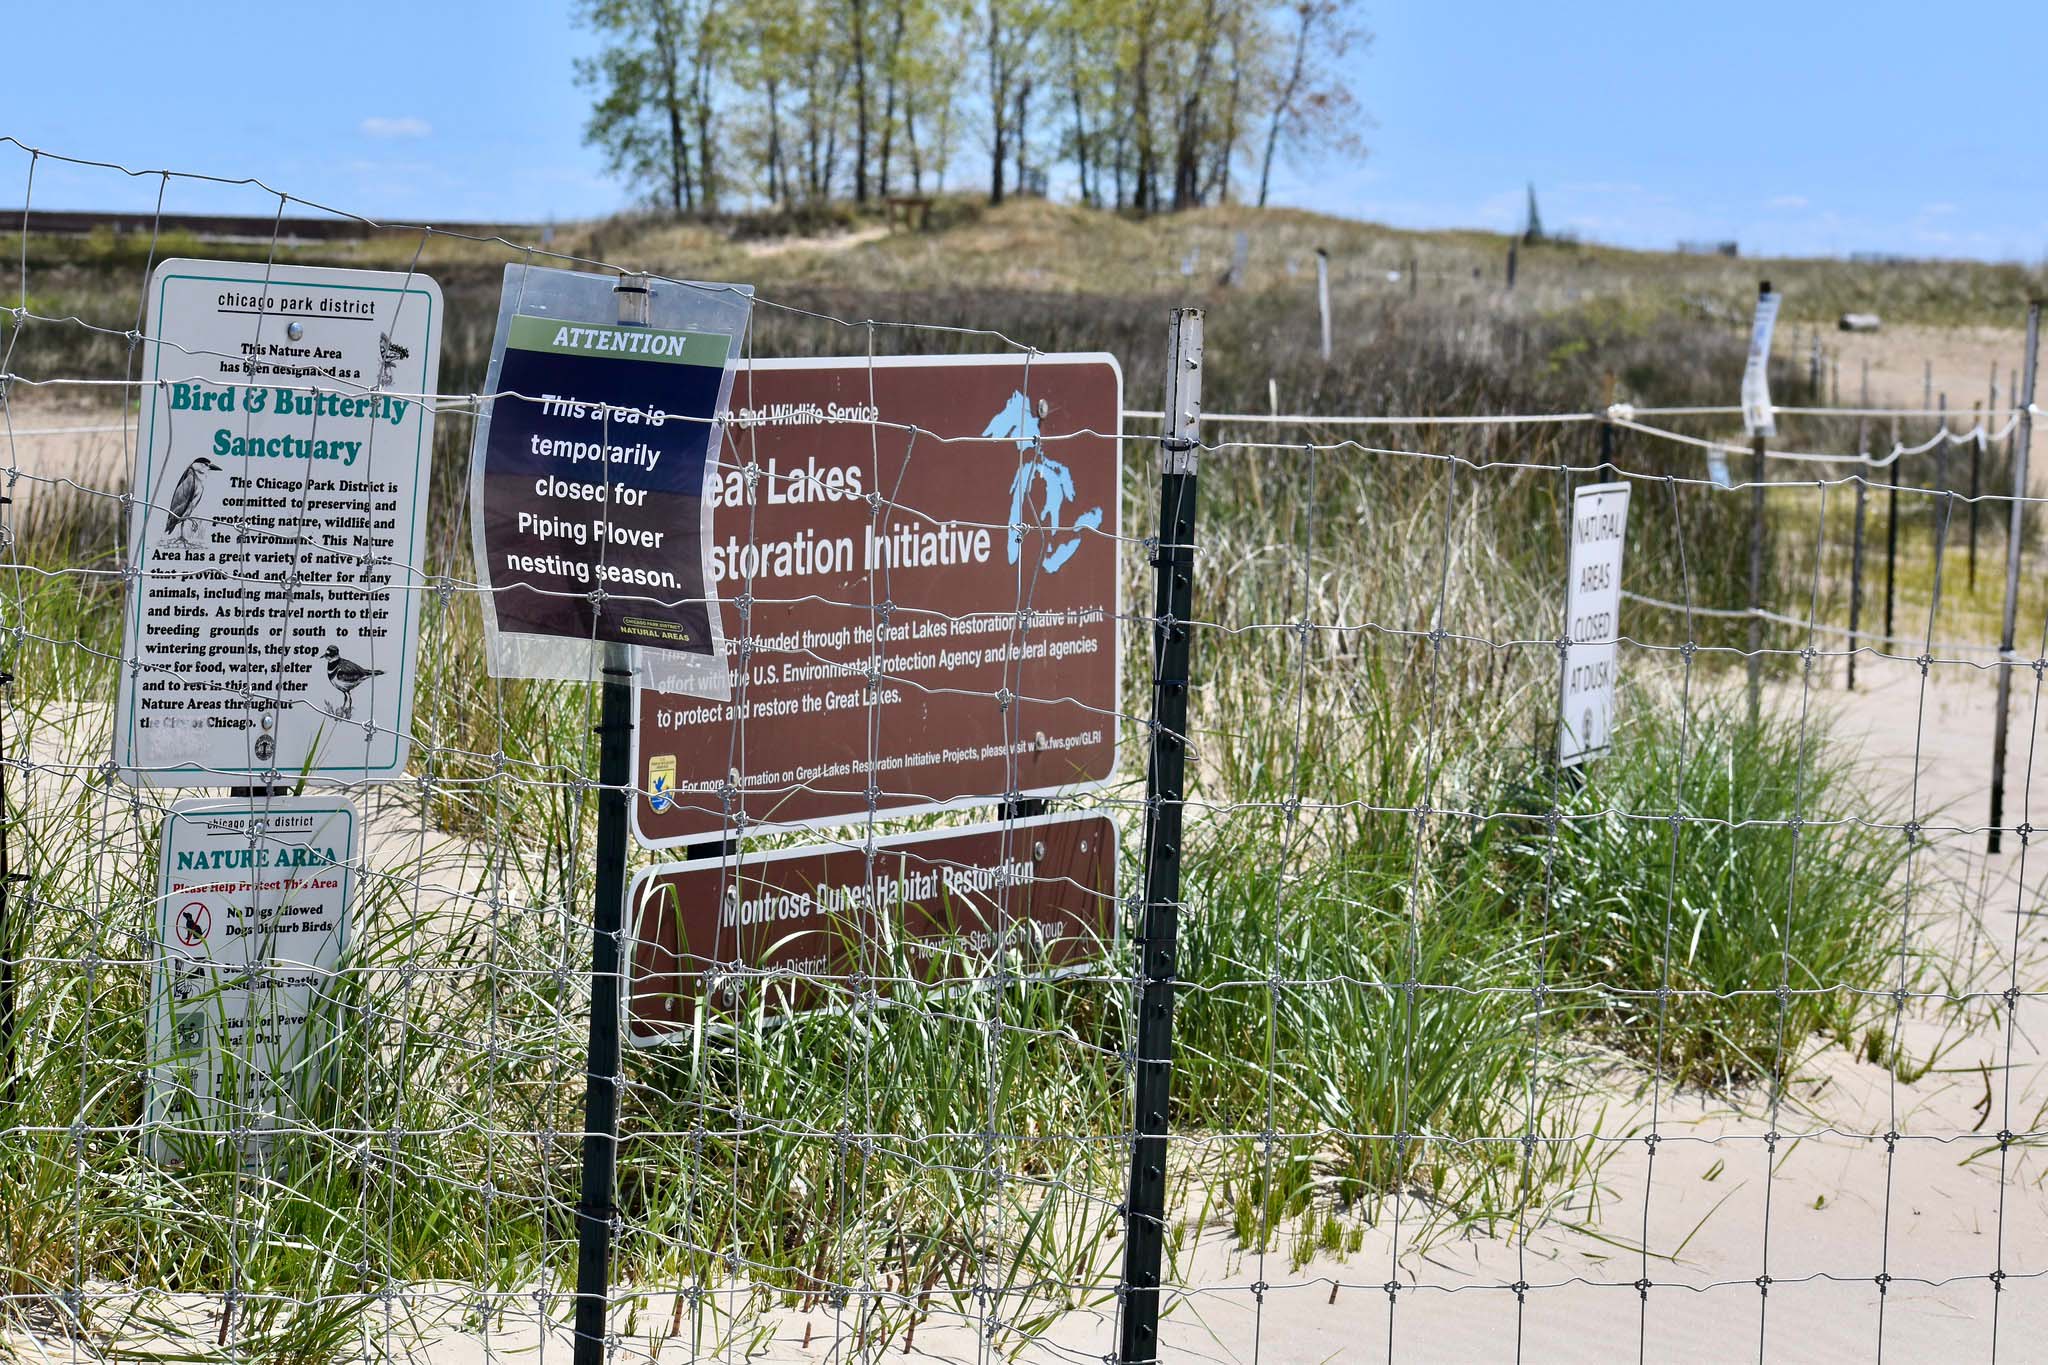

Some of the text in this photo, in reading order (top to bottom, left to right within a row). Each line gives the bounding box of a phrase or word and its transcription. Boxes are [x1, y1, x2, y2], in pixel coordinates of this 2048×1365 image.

[218, 292, 375, 315] chicago park district
[241, 343, 342, 359] This Nature Area
[553, 326, 687, 357] ATTENTION
[220, 361, 360, 378] has designated as a
[171, 383, 235, 412] Bird
[243, 387, 268, 414] &
[541, 393, 666, 427] This area is
[771, 402, 879, 426] Wildlife Service
[213, 428, 363, 466] Sanctuary
[531, 434, 661, 472] temporarily
[230, 476, 398, 493] The Chicago Park District is
[535, 475, 648, 507] closed for
[767, 456, 862, 505] Lakes
[222, 497, 396, 513] committed to preserving and
[212, 515, 395, 529] protecting nature, wildlife and
[518, 511, 664, 549] Piping Plover
[1576, 512, 1621, 545] NATURAL
[211, 532, 394, 547] the This Nature
[152, 549, 353, 565] Area has a great variety of native
[711, 522, 991, 583] storation Initiative
[264, 571, 286, 581] and
[336, 572, 355, 582] for
[360, 574, 392, 585] many
[507, 553, 682, 590] nesting season.
[1580, 563, 1610, 593] AREAS
[149, 587, 390, 602] animals, including mammals, butterflies
[148, 606, 389, 619] and birds. As birds travel north to their
[146, 624, 388, 638] breeding grounds or south to their
[620, 626, 690, 642] NATURAL AREAS
[755, 631, 800, 653] funded
[802, 626, 850, 650] through
[854, 625, 873, 644] the
[876, 622, 910, 642] Great
[912, 619, 947, 639] Lakes
[950, 616, 1016, 637] Restoration
[1067, 607, 1078, 625] in
[1079, 604, 1104, 628] joint
[1575, 612, 1610, 643] CLOSED
[145, 643, 319, 657] wintering they stop
[143, 661, 312, 675] over for food, water, shelter
[729, 668, 750, 688] the
[753, 665, 779, 686] U.S.
[783, 656, 872, 682] Environmental
[875, 651, 936, 675] Protection
[939, 648, 981, 671] Agency
[985, 643, 1006, 663] and
[1009, 639, 1047, 660] federal
[1049, 636, 1098, 660] agencies
[142, 680, 308, 691] and to rest in this and other
[1570, 661, 1610, 696] AT DUSK
[141, 698, 220, 710] Nature Areas
[657, 688, 902, 731] to protect and restore the Great Lakes.
[206, 716, 257, 730] Chicago.
[682, 742, 1008, 794] For more on Great Lakes Restoration Initiative Projects, please
[208, 817, 245, 829] chicago
[275, 816, 313, 827] district
[177, 847, 337, 871] NATURE AREA
[210, 881, 236, 895] Help
[283, 879, 308, 889] This
[311, 878, 338, 889] Area
[723, 857, 1034, 928] Montrose Dunes Habitat Restortion
[227, 908, 242, 918] No
[226, 925, 252, 937] Dogs
[302, 920, 332, 932] Birds
